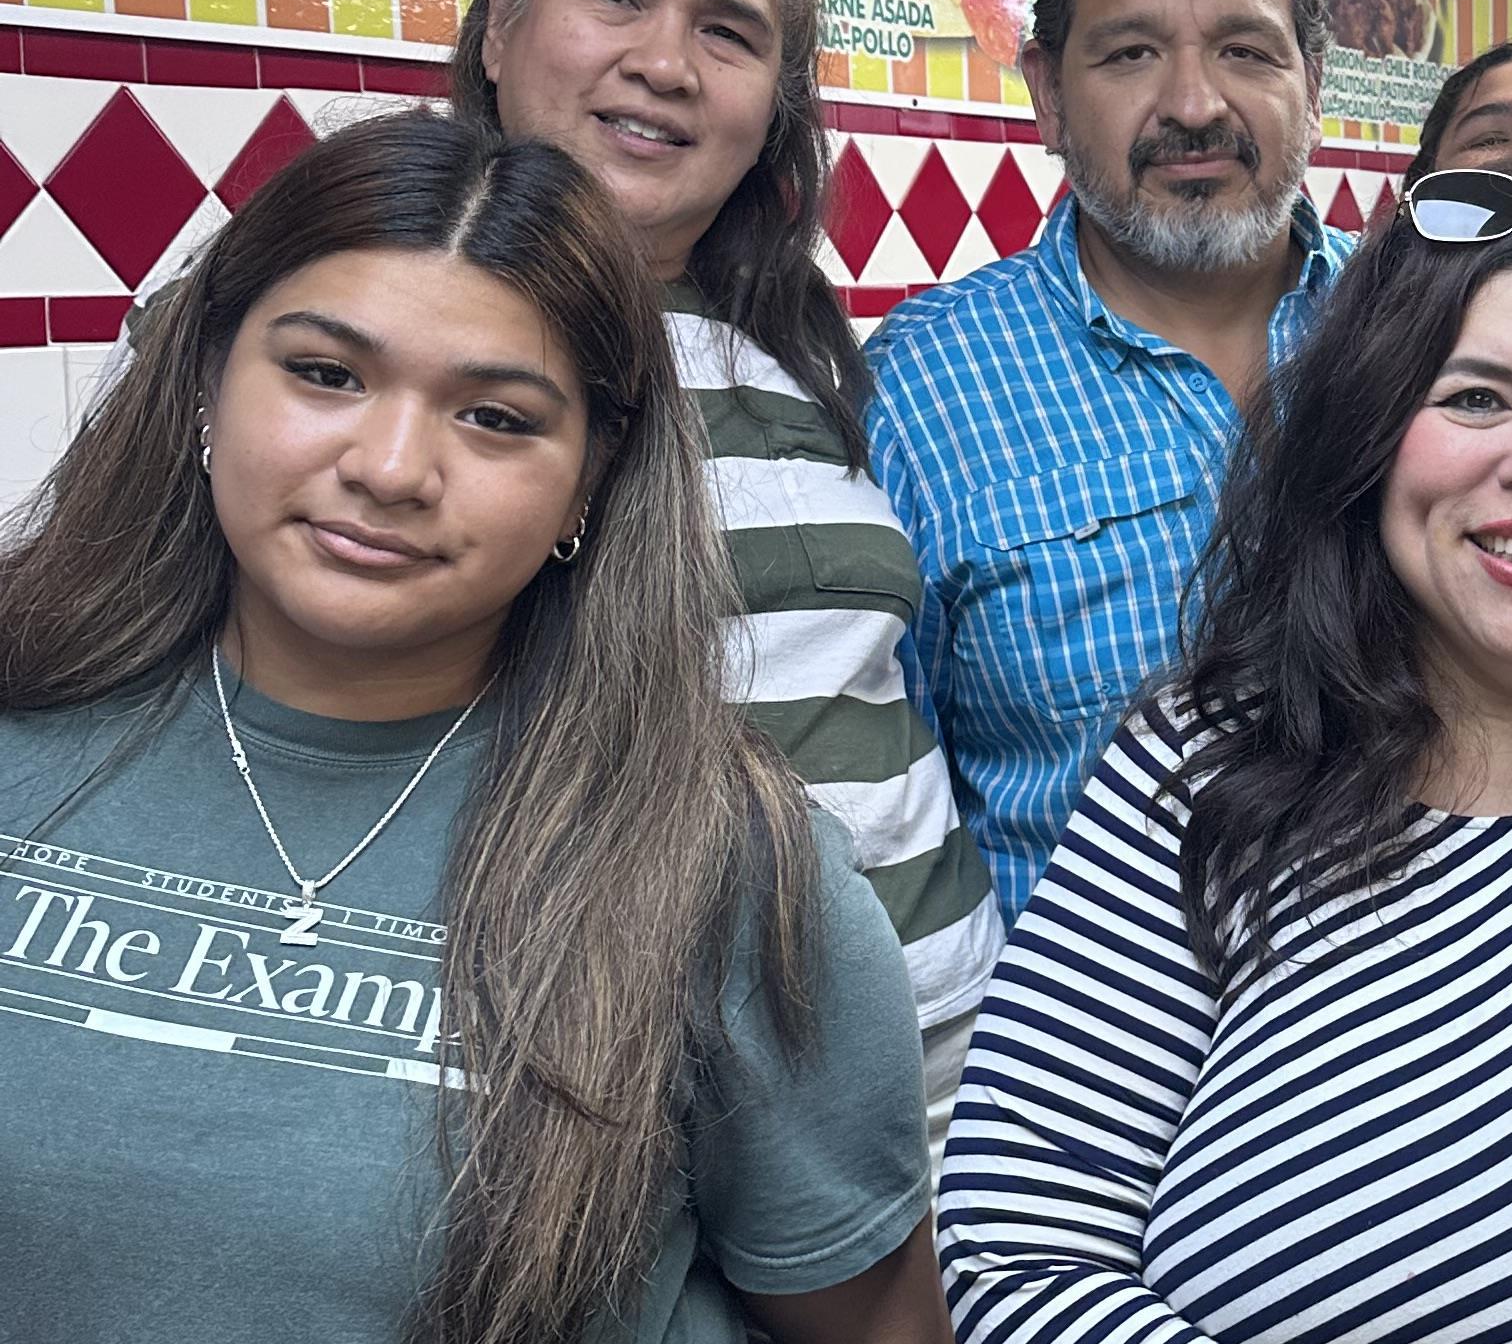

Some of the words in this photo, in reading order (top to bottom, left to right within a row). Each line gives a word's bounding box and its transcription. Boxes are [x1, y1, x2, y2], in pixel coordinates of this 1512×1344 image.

[12, 843, 91, 872] HOPE
[142, 871, 294, 914] STUDENTS
[3, 885, 161, 983] The
